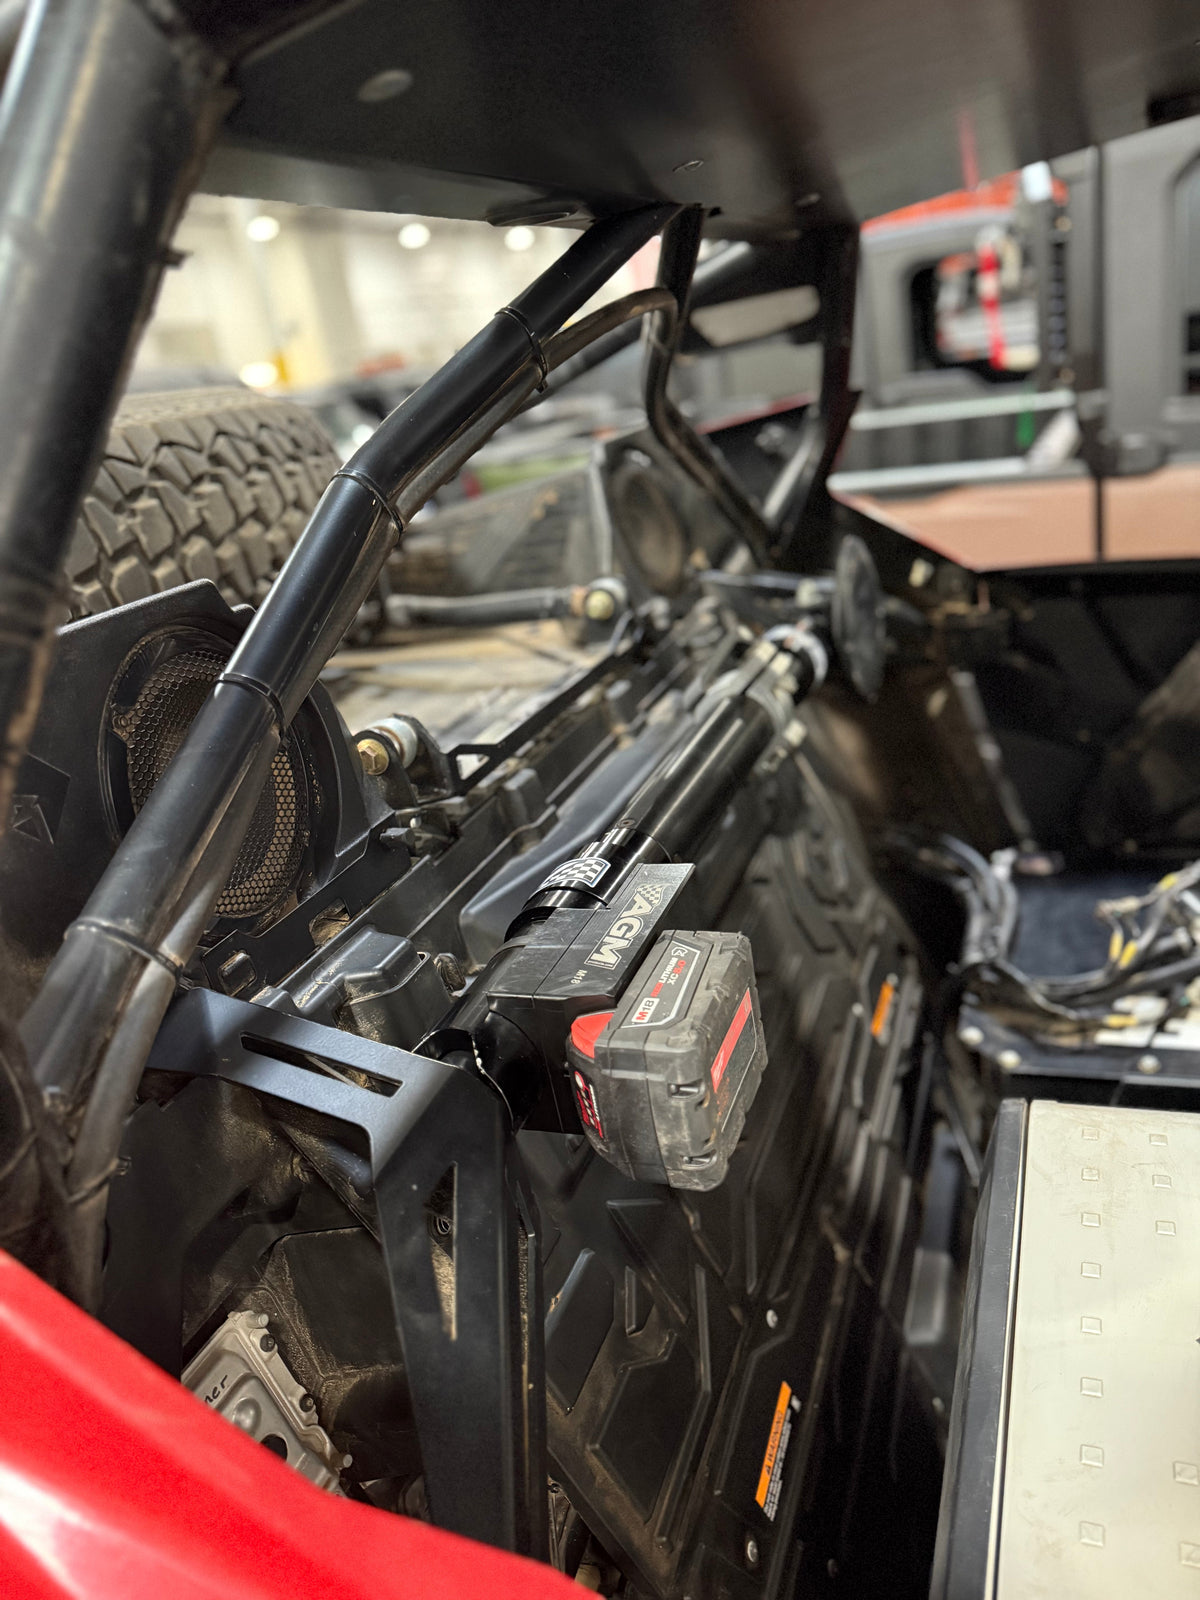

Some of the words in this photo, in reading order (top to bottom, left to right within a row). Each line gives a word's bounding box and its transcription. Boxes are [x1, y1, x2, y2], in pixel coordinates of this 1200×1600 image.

[588, 891, 654, 966] AGM
[570, 969, 588, 985] M18
[635, 999, 655, 1021] M18
